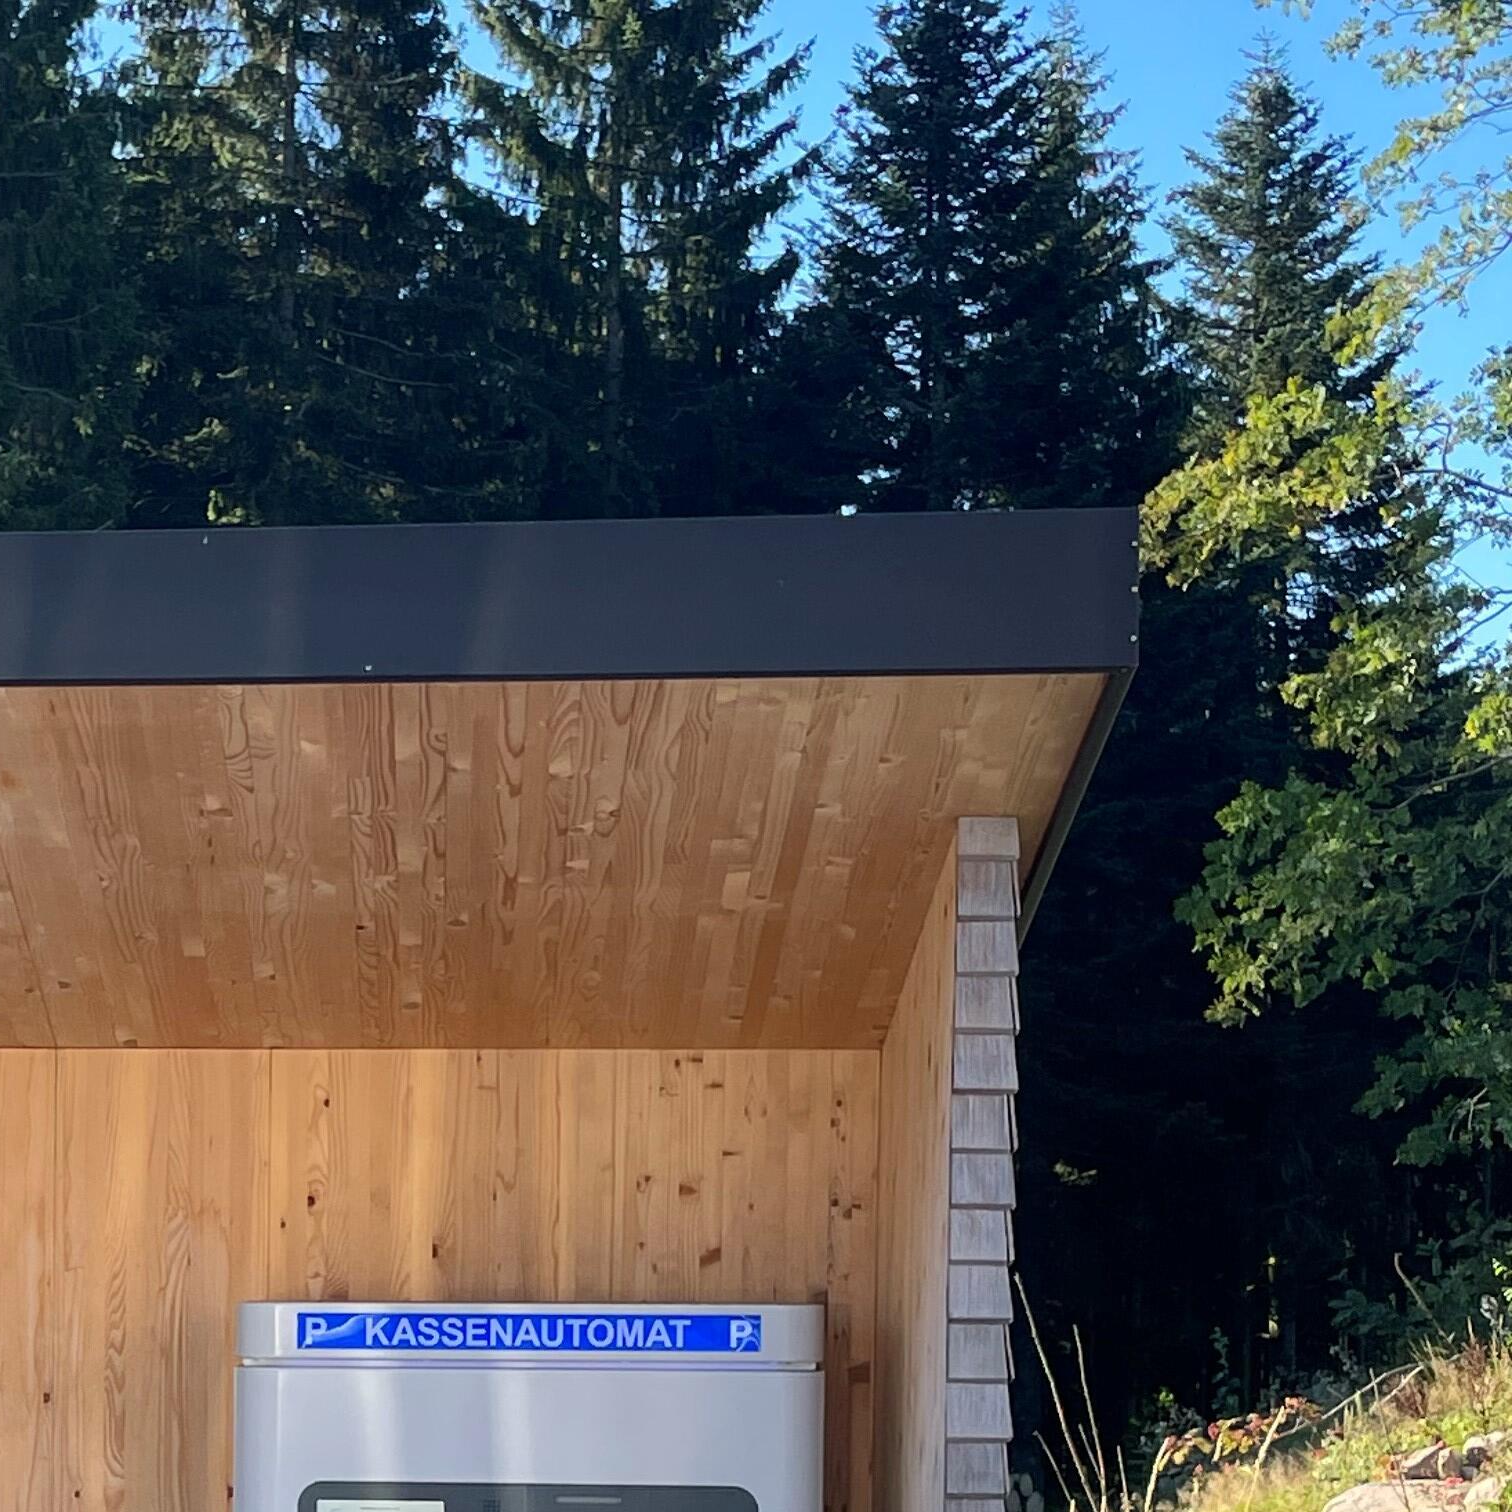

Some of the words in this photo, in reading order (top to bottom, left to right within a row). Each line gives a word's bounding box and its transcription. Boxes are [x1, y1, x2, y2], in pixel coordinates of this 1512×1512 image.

[305, 1316, 328, 1346] P
[365, 1316, 692, 1349] KASSENAUTOMAT
[729, 1319, 752, 1347] P
